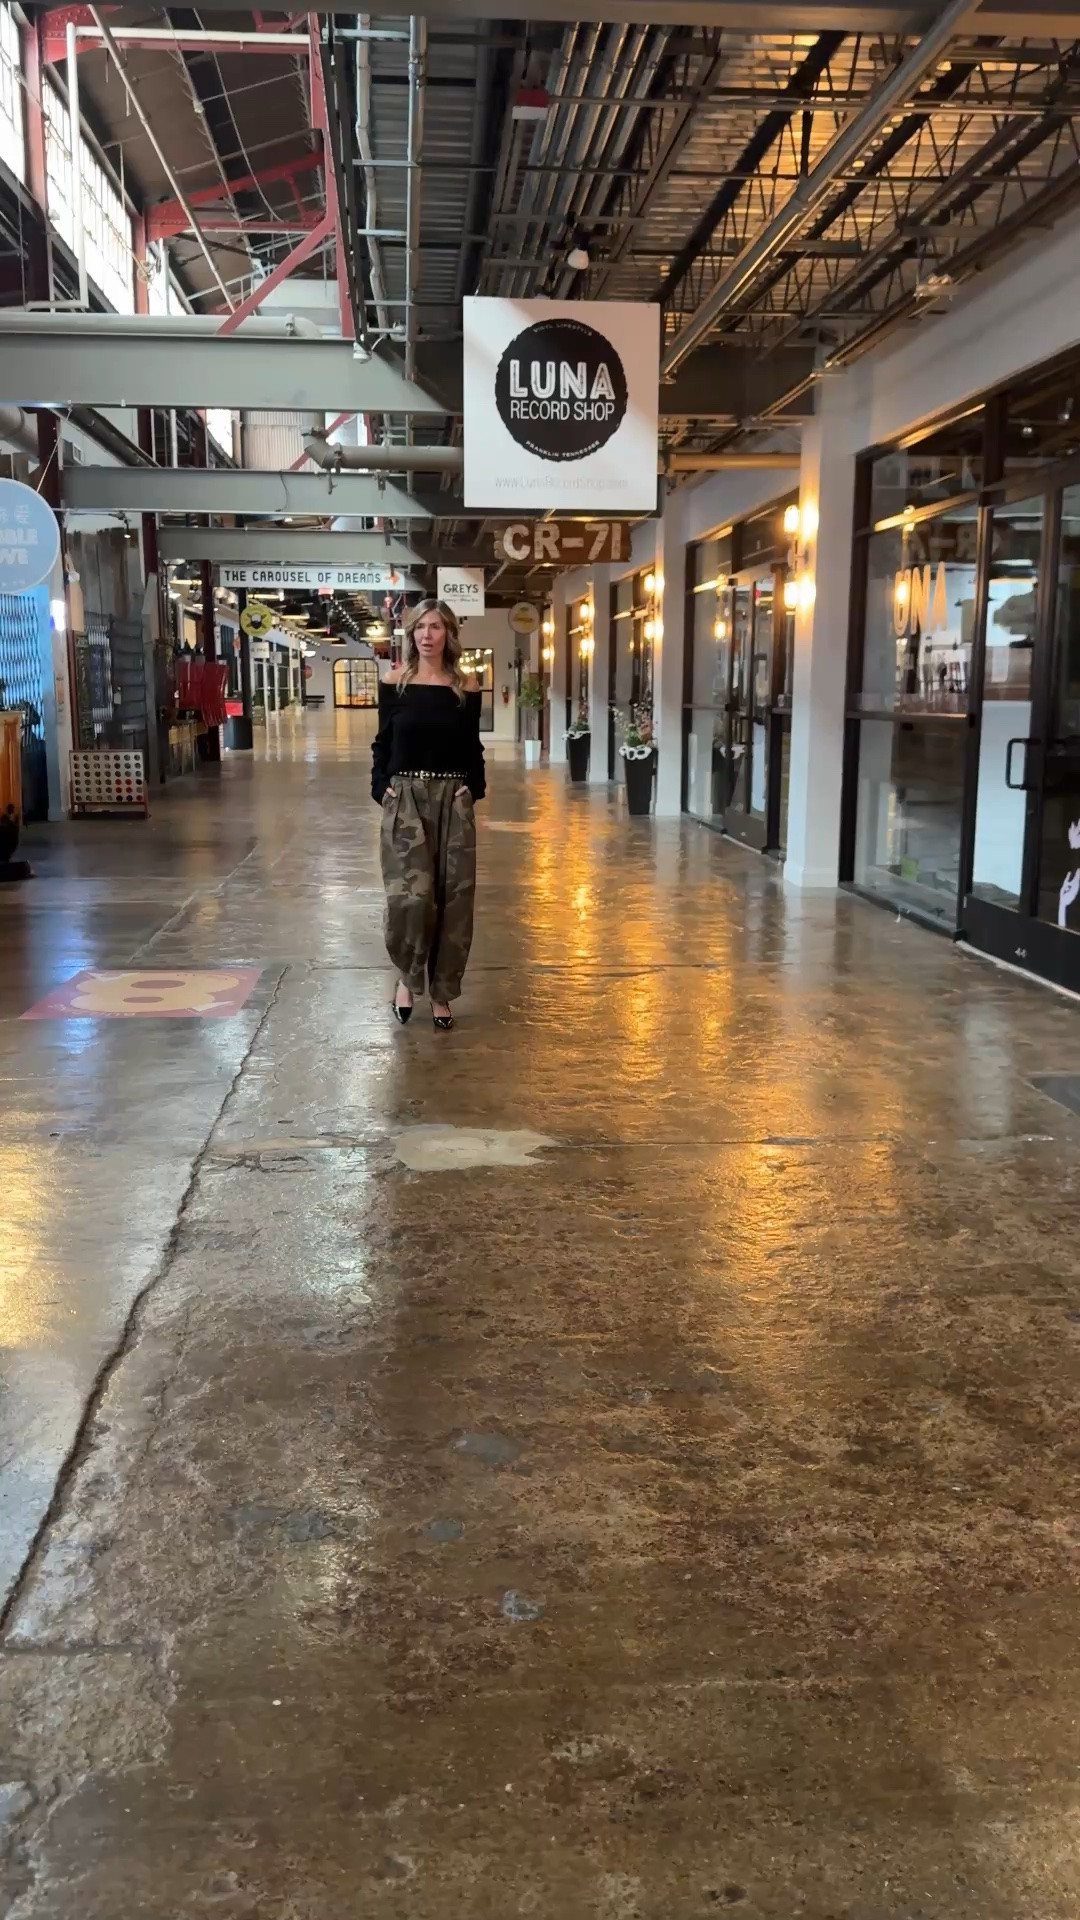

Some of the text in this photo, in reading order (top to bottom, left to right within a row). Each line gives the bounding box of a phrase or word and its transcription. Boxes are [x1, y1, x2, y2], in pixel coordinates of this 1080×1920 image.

[509, 359, 616, 400] LUNA
[510, 400, 615, 421] RECORD SHOP
[525, 440, 600, 457] FRANKLIN TENNESSEE
[502, 522, 622, 561] CR-71
[224, 570, 381, 584] THE CAROUSEL OF DREAMS
[443, 583, 479, 594] GREYS
